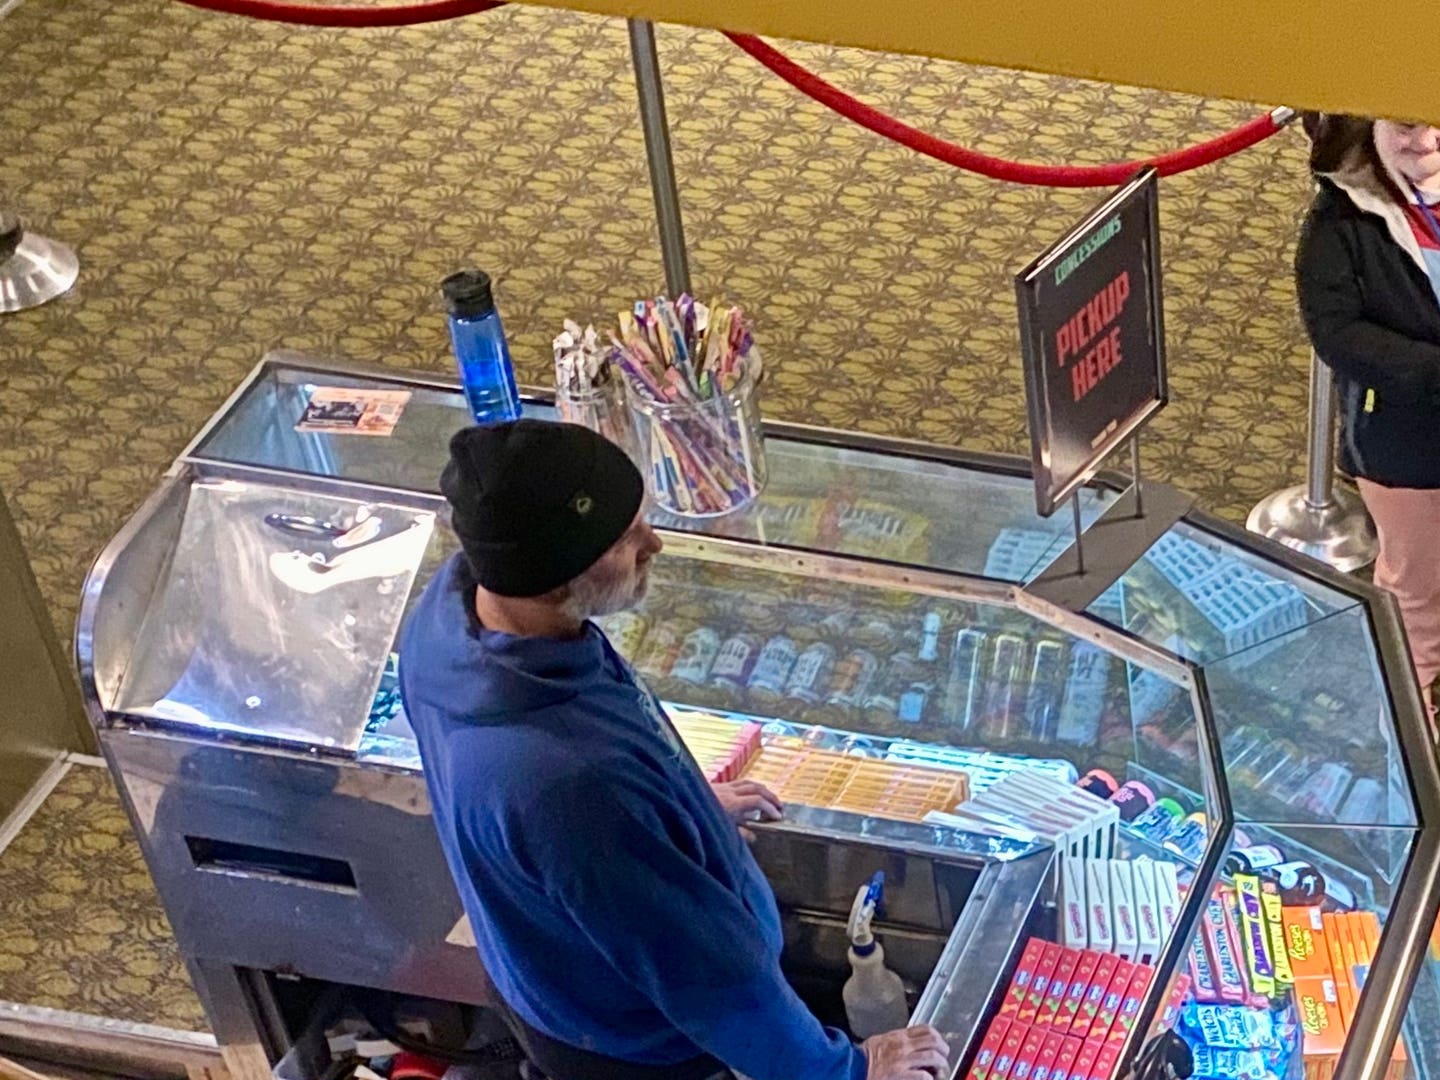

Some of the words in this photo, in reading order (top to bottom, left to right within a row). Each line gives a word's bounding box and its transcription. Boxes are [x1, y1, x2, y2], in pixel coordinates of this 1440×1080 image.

[1055, 213, 1121, 285] CONCESSIONS
[1055, 271, 1130, 367] PICKUP
[1071, 326, 1122, 401] HERE
